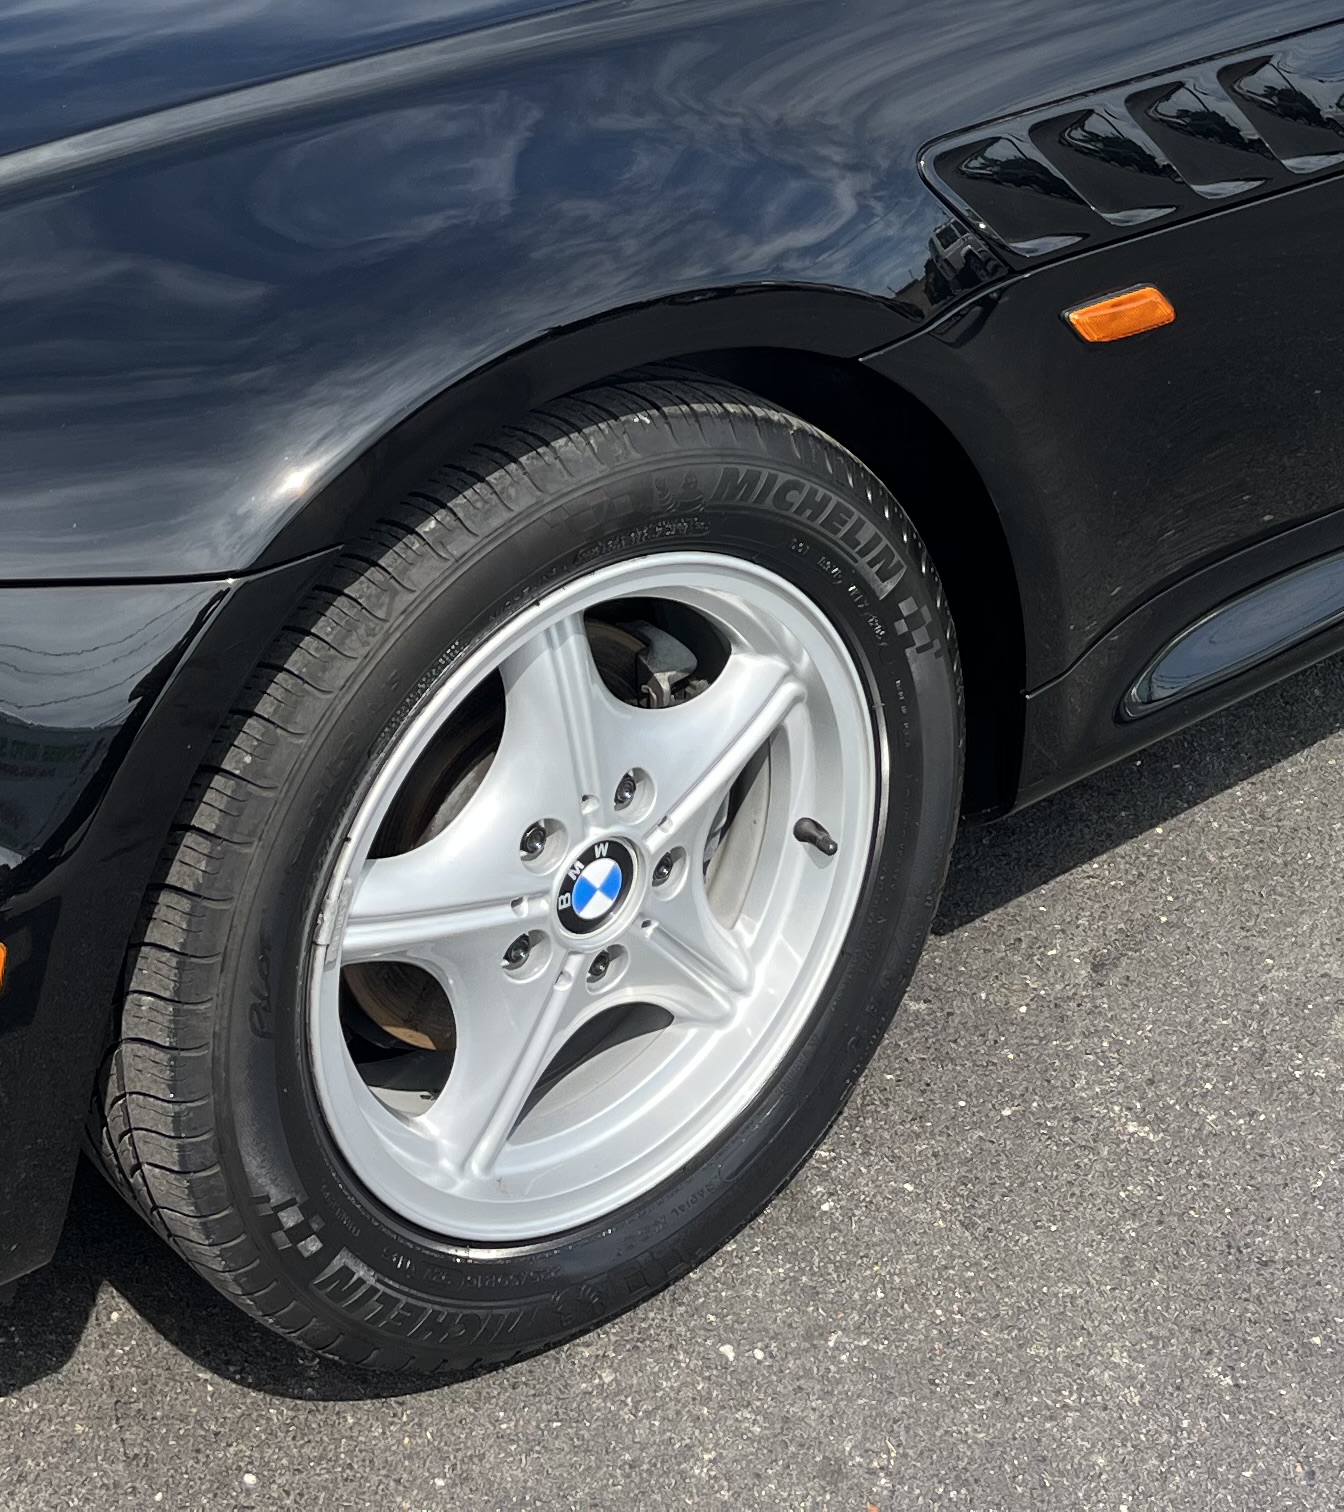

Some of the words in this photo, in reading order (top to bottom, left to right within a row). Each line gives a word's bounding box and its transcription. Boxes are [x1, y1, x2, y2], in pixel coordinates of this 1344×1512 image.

[710, 466, 907, 587] MICHELIN
[558, 842, 609, 910] BMW
[313, 1259, 540, 1347] MICHELIN
